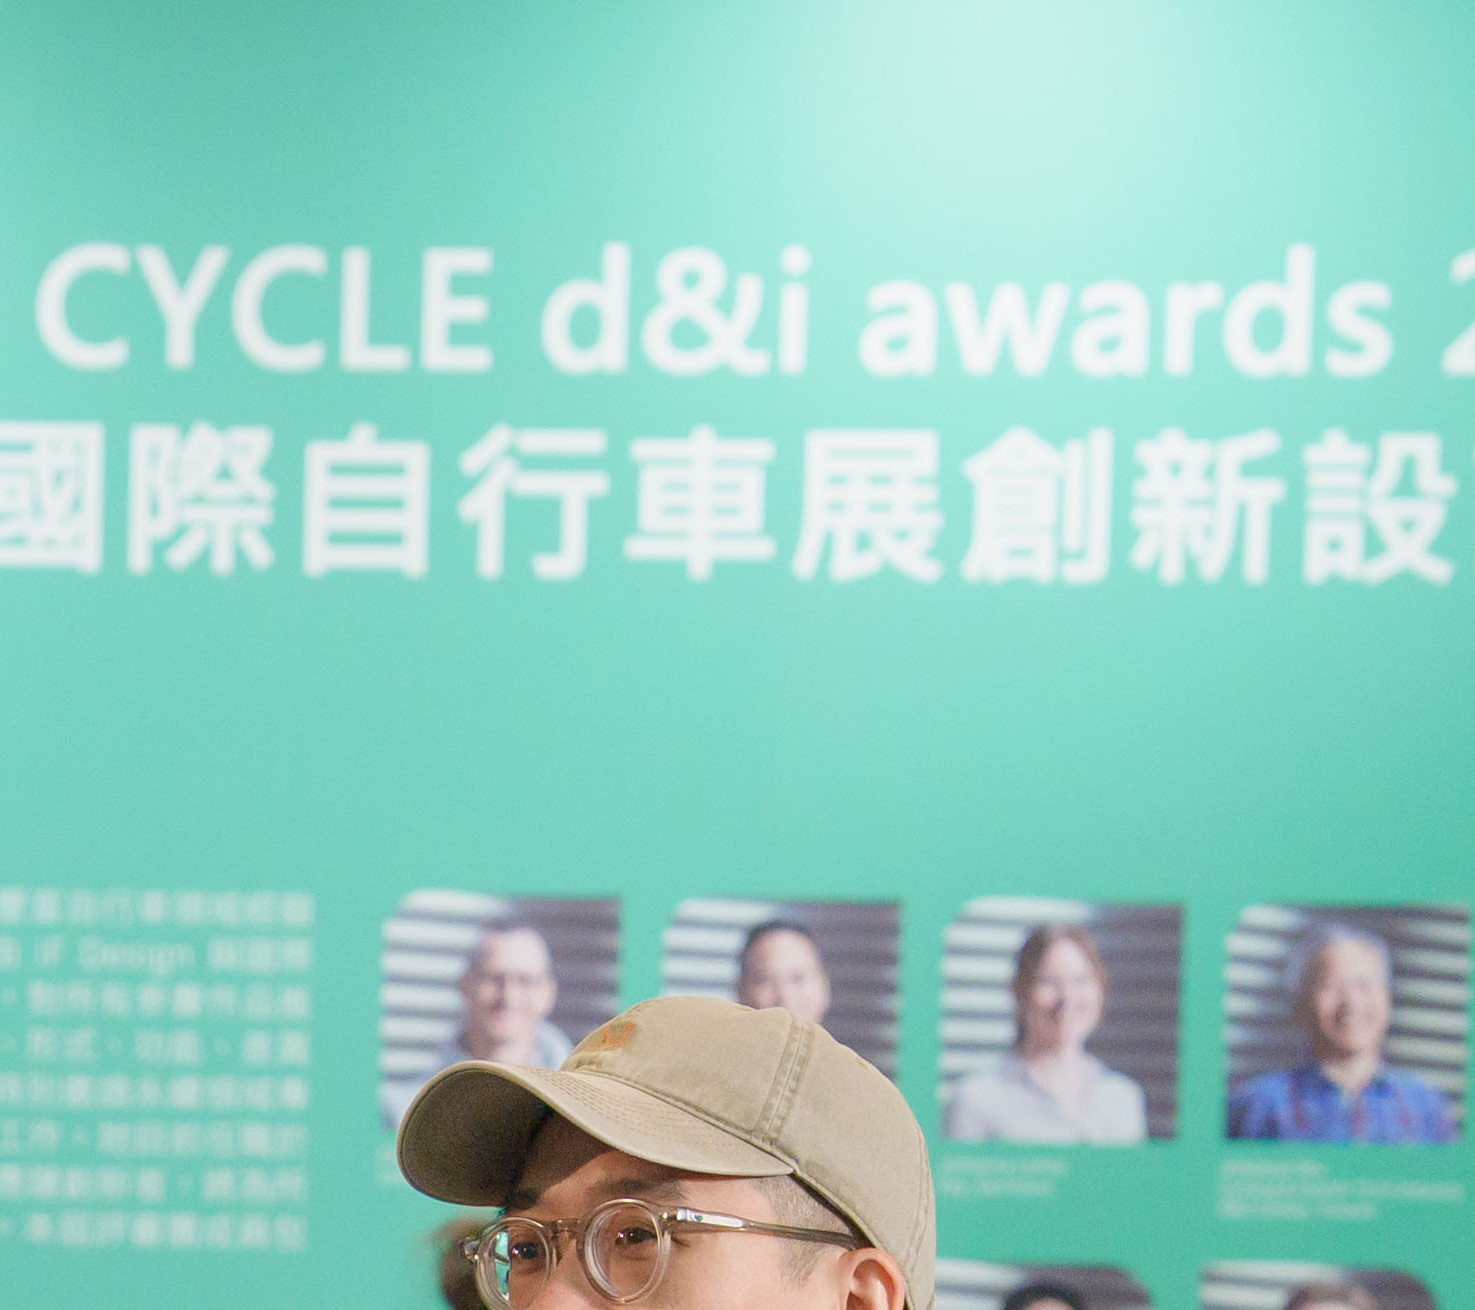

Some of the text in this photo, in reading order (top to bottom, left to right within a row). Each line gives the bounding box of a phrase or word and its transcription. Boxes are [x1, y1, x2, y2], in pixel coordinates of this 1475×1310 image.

[34, 241, 493, 373] CYCLE
[540, 241, 810, 376] d&i
[858, 242, 1393, 378] awards
